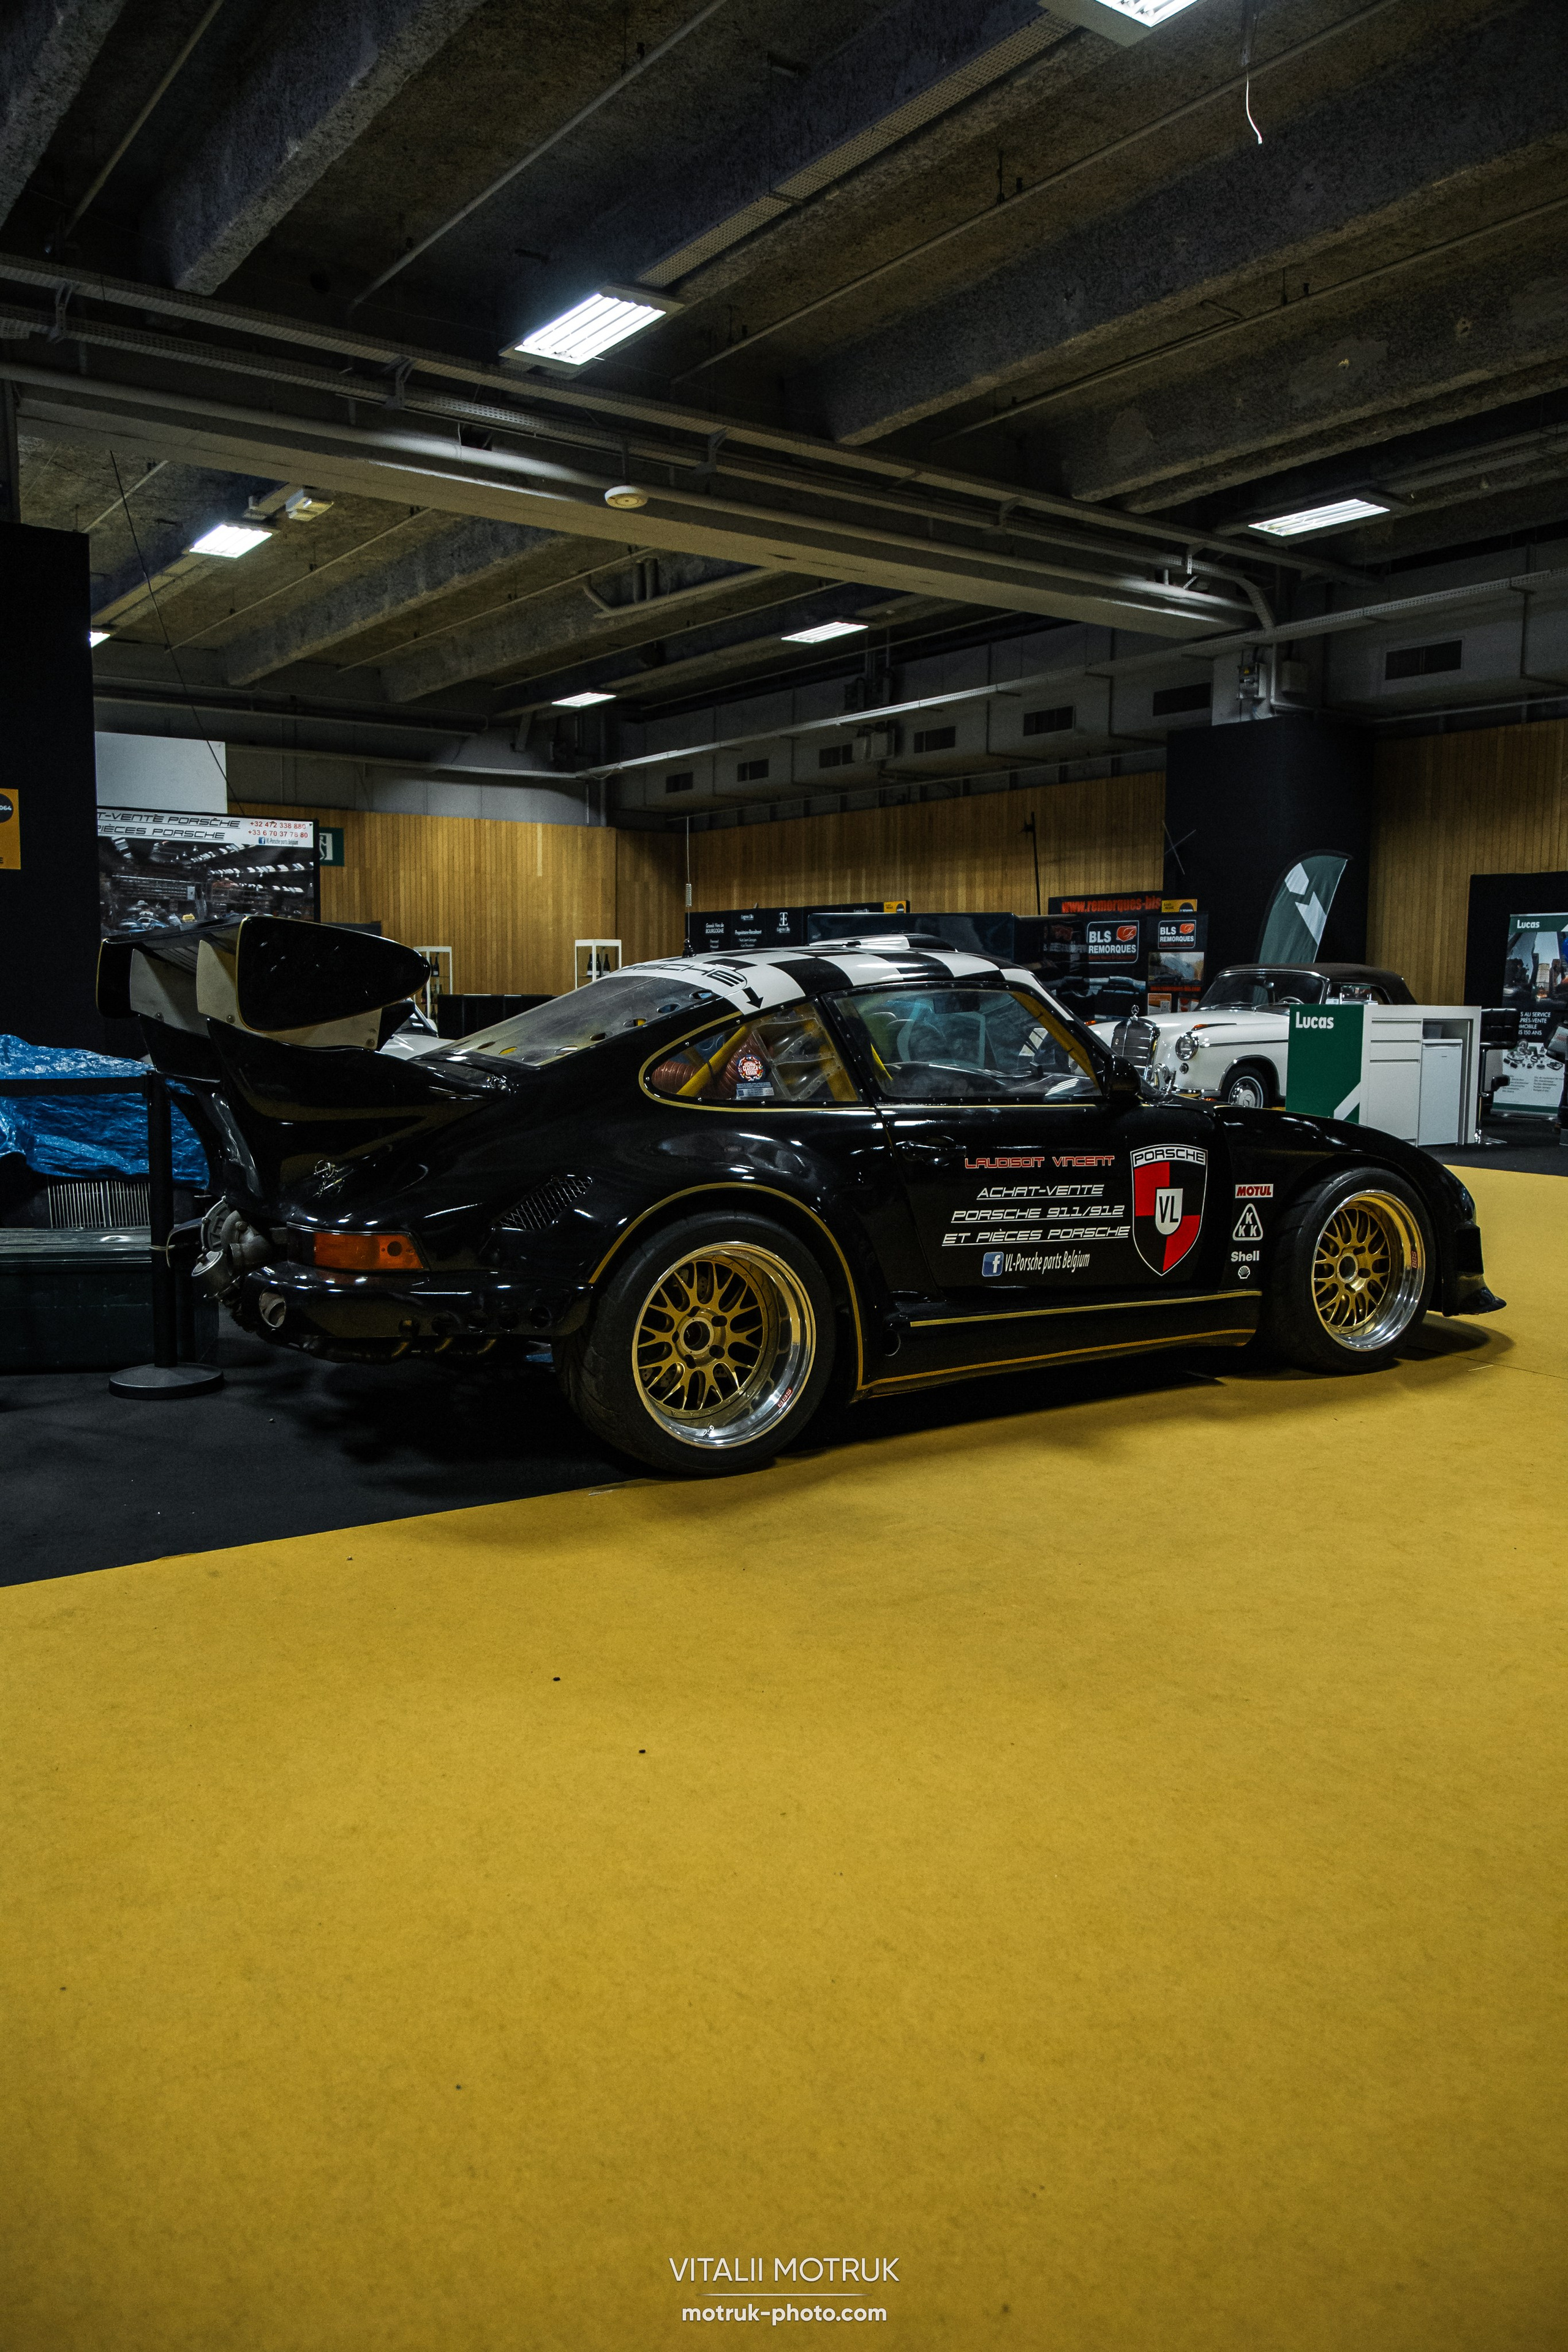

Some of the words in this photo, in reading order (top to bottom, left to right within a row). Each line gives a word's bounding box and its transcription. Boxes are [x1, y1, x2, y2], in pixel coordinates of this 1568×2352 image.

[167, 816, 241, 827] PORSCHE
[152, 828, 225, 839] PORSCHE
[1160, 926, 1177, 935] BLS
[1517, 919, 1540, 929] Lucas
[1089, 930, 1112, 943] BLS
[1088, 944, 1136, 954] REMORQUES
[1295, 1011, 1334, 1029] Lucas
[965, 1157, 1045, 1169] LAUDISOIT
[1052, 1155, 1115, 1167] VINCENT
[1134, 1149, 1205, 1166] PORSCHE
[976, 1184, 1105, 1198] ACHAT-VENTE
[1236, 1185, 1272, 1196] MOTUL
[951, 1208, 1042, 1221] PORSCHE
[1046, 1205, 1125, 1218] 911/912
[1158, 1195, 1180, 1223] VL
[942, 1232, 971, 1244] ET
[976, 1228, 1043, 1243] PIÈCES
[1047, 1226, 1131, 1240] PORSCHE
[1005, 1251, 1042, 1272] VL-Porsche
[1042, 1253, 1062, 1275] parts
[1061, 1250, 1090, 1273] Belgium
[1231, 1250, 1260, 1262] Shell
[777, 1387, 793, 1408] BBS
